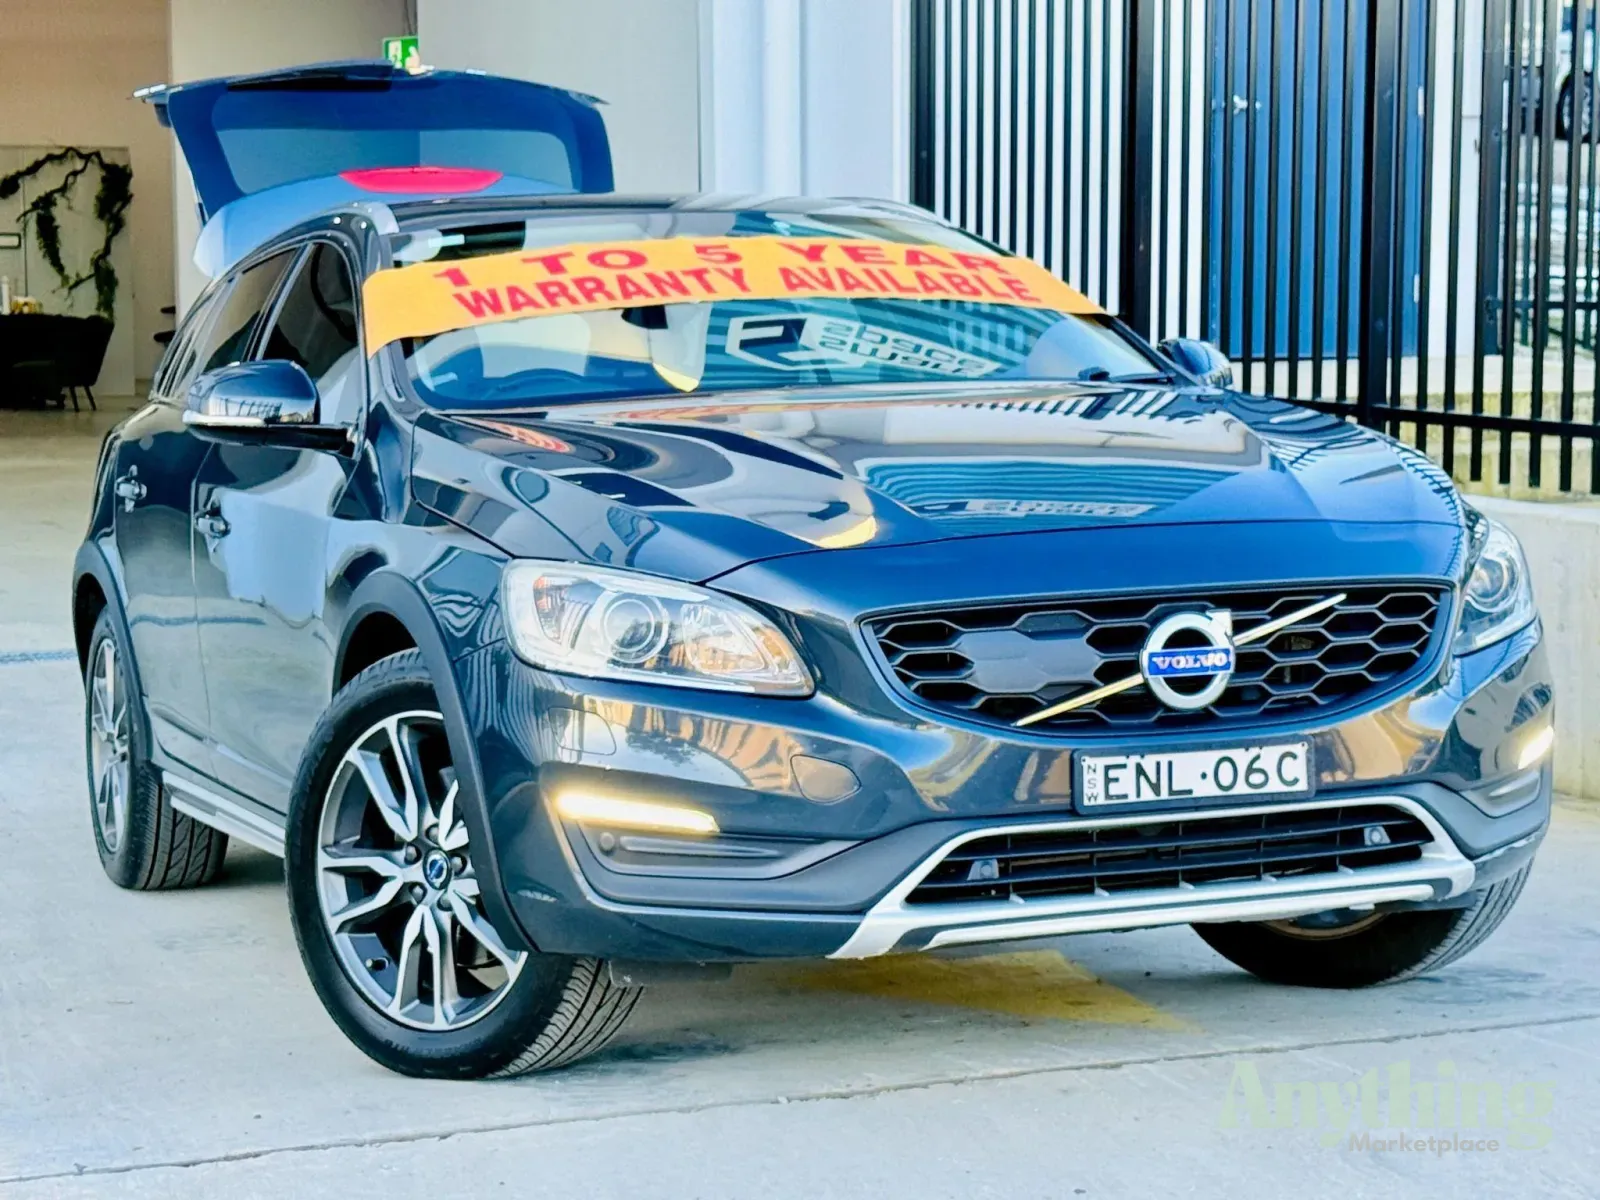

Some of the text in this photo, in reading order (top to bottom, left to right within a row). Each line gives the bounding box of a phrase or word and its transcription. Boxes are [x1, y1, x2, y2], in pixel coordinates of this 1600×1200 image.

[433, 242, 1012, 287] 1 TO 5 YEAR
[451, 266, 1042, 318] WARRANTY AVAILABLE
[1151, 652, 1229, 670] VOLVO
[1085, 763, 1099, 803] NSW
